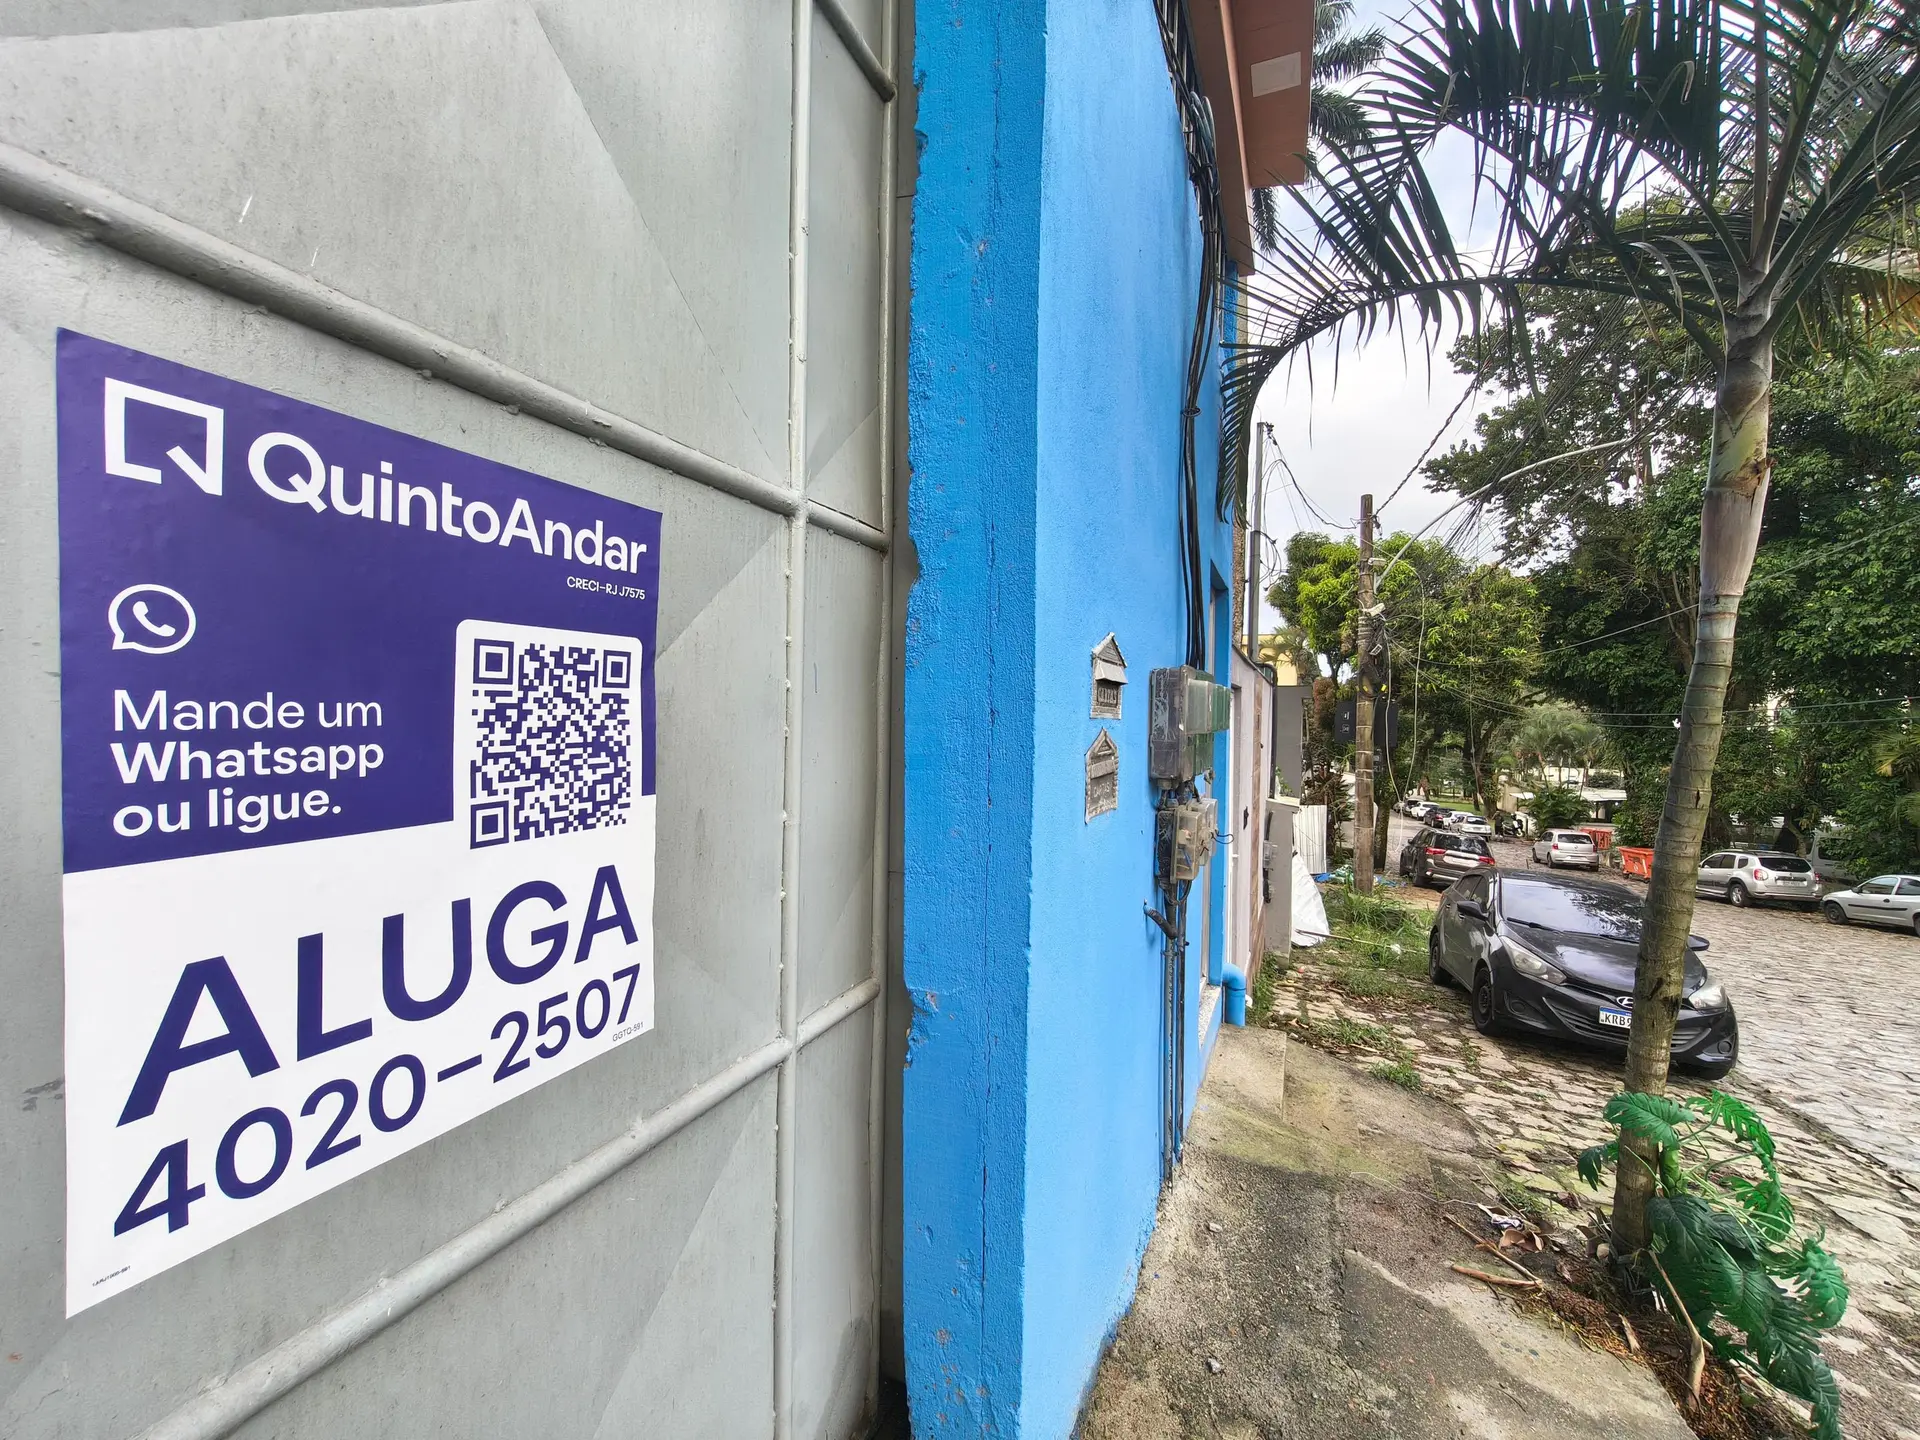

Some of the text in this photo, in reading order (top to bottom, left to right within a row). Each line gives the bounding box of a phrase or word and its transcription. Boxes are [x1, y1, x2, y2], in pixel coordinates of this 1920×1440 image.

[247, 431, 647, 574] QuintoAndar
[566, 576, 646, 600] CRECI-RJ J7575
[114, 689, 383, 731] Mande um
[110, 741, 384, 783] Whatsapp
[112, 787, 342, 837] ou ligue.
[115, 864, 639, 1128] ALUGA
[113, 962, 641, 1238] 4020-2507
